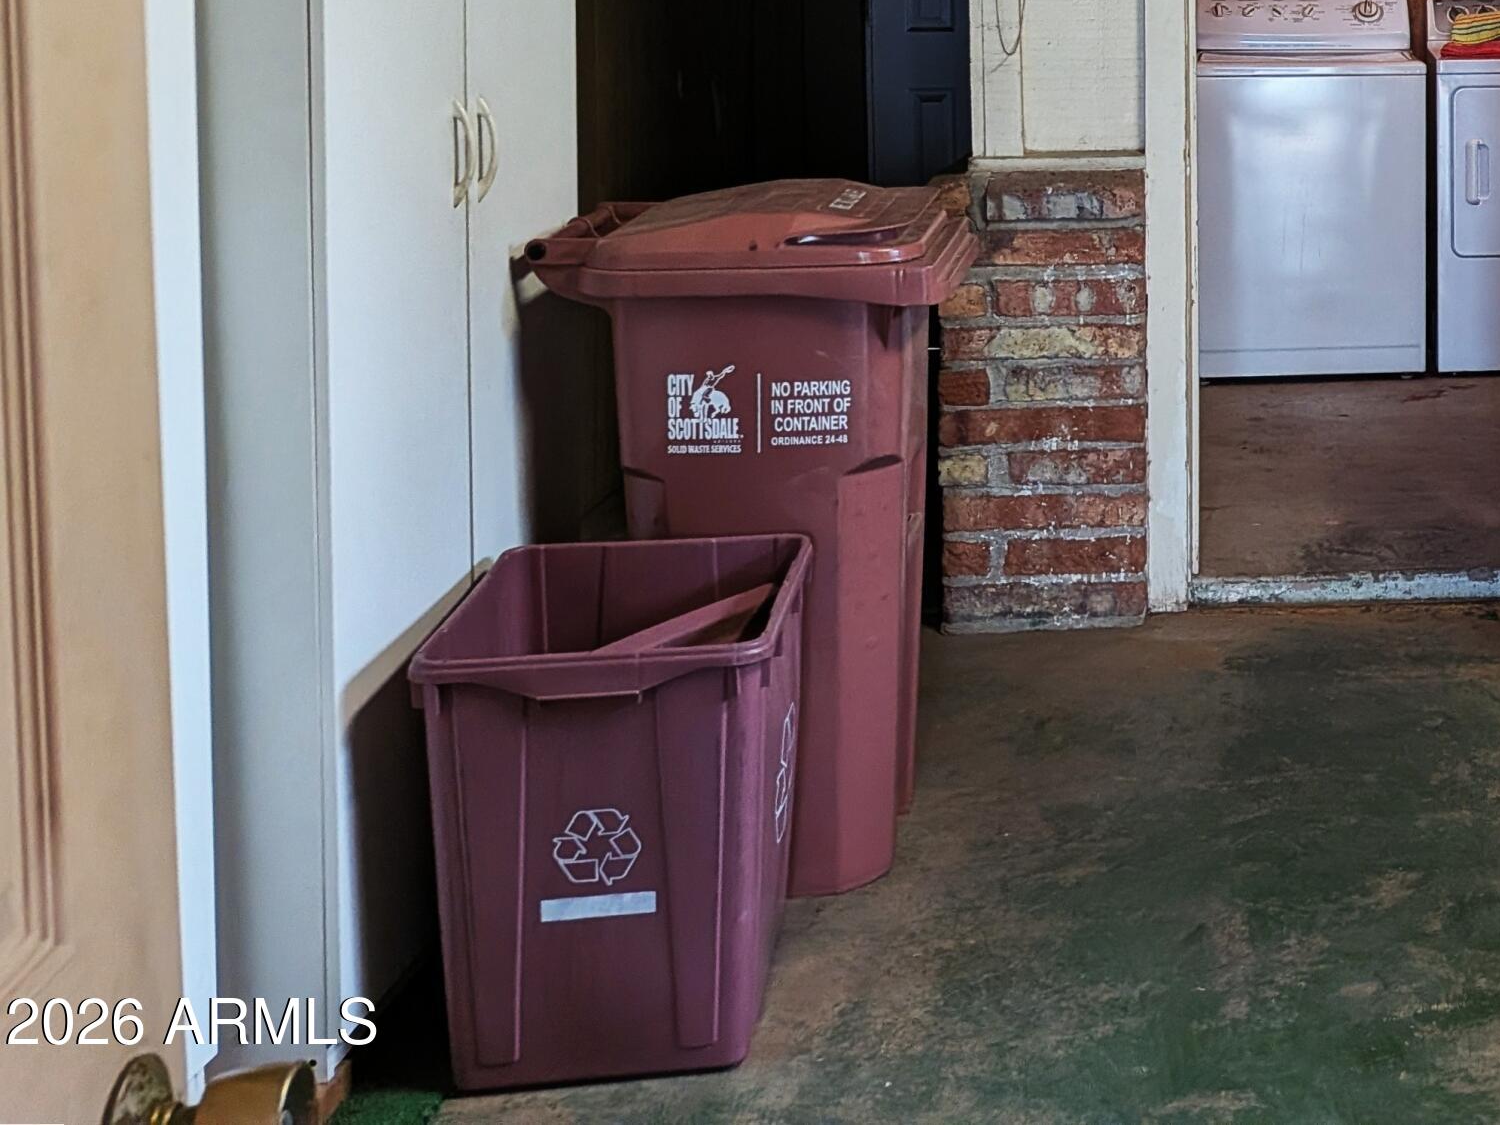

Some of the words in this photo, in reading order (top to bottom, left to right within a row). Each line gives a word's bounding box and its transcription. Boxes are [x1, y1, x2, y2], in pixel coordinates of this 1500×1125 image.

[667, 374, 695, 396] CITY
[771, 381, 791, 397] NO
[793, 379, 851, 396] PARKING
[667, 396, 683, 418] OF
[771, 399, 784, 415] IN
[787, 398, 831, 414] FRONT
[833, 397, 851, 413] OF
[774, 415, 849, 432] CONTAINER
[667, 445, 687, 454] SOLID
[688, 445, 710, 454] WASTE
[710, 445, 742, 454] SERVICES
[771, 435, 823, 446] ORDINANCE
